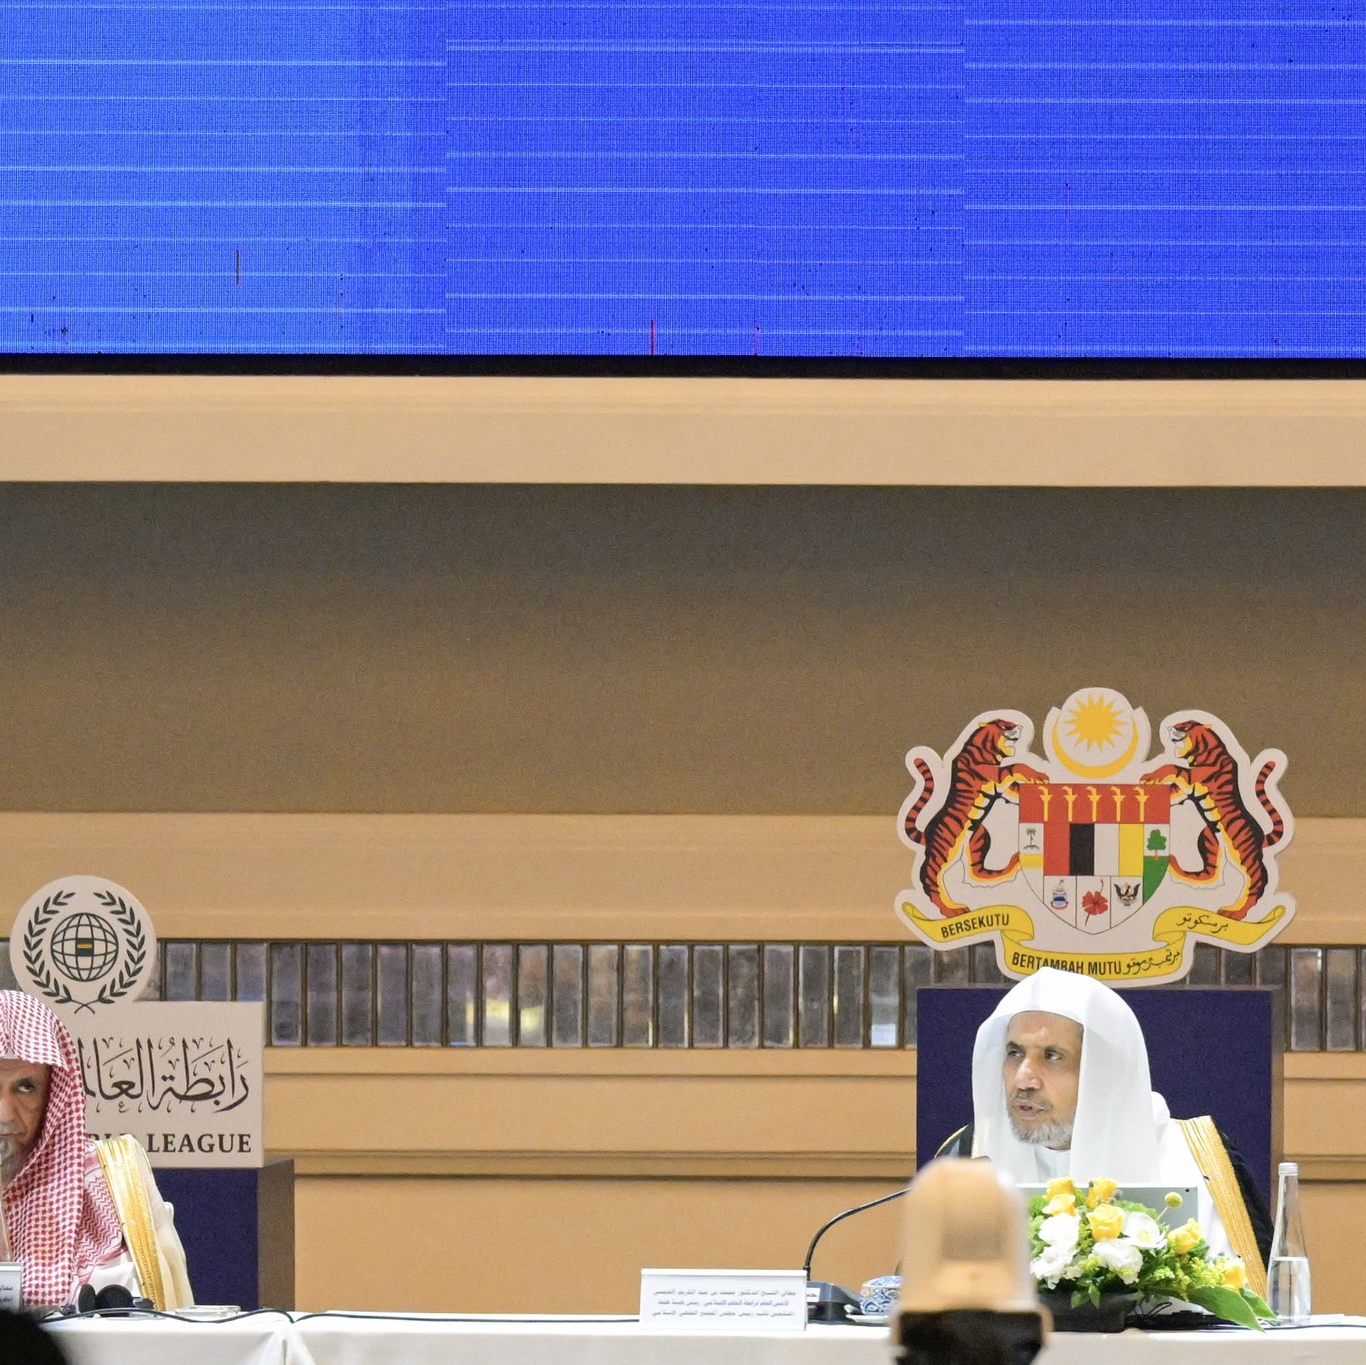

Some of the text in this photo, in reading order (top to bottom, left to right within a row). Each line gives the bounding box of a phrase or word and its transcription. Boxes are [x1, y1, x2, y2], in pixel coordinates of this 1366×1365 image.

[940, 913, 1011, 939] BERSEKUTU
[1088, 960, 1122, 976] MUTU
[147, 1036, 250, 1114] رابطة
[147, 1132, 252, 1153] LEAGUE
